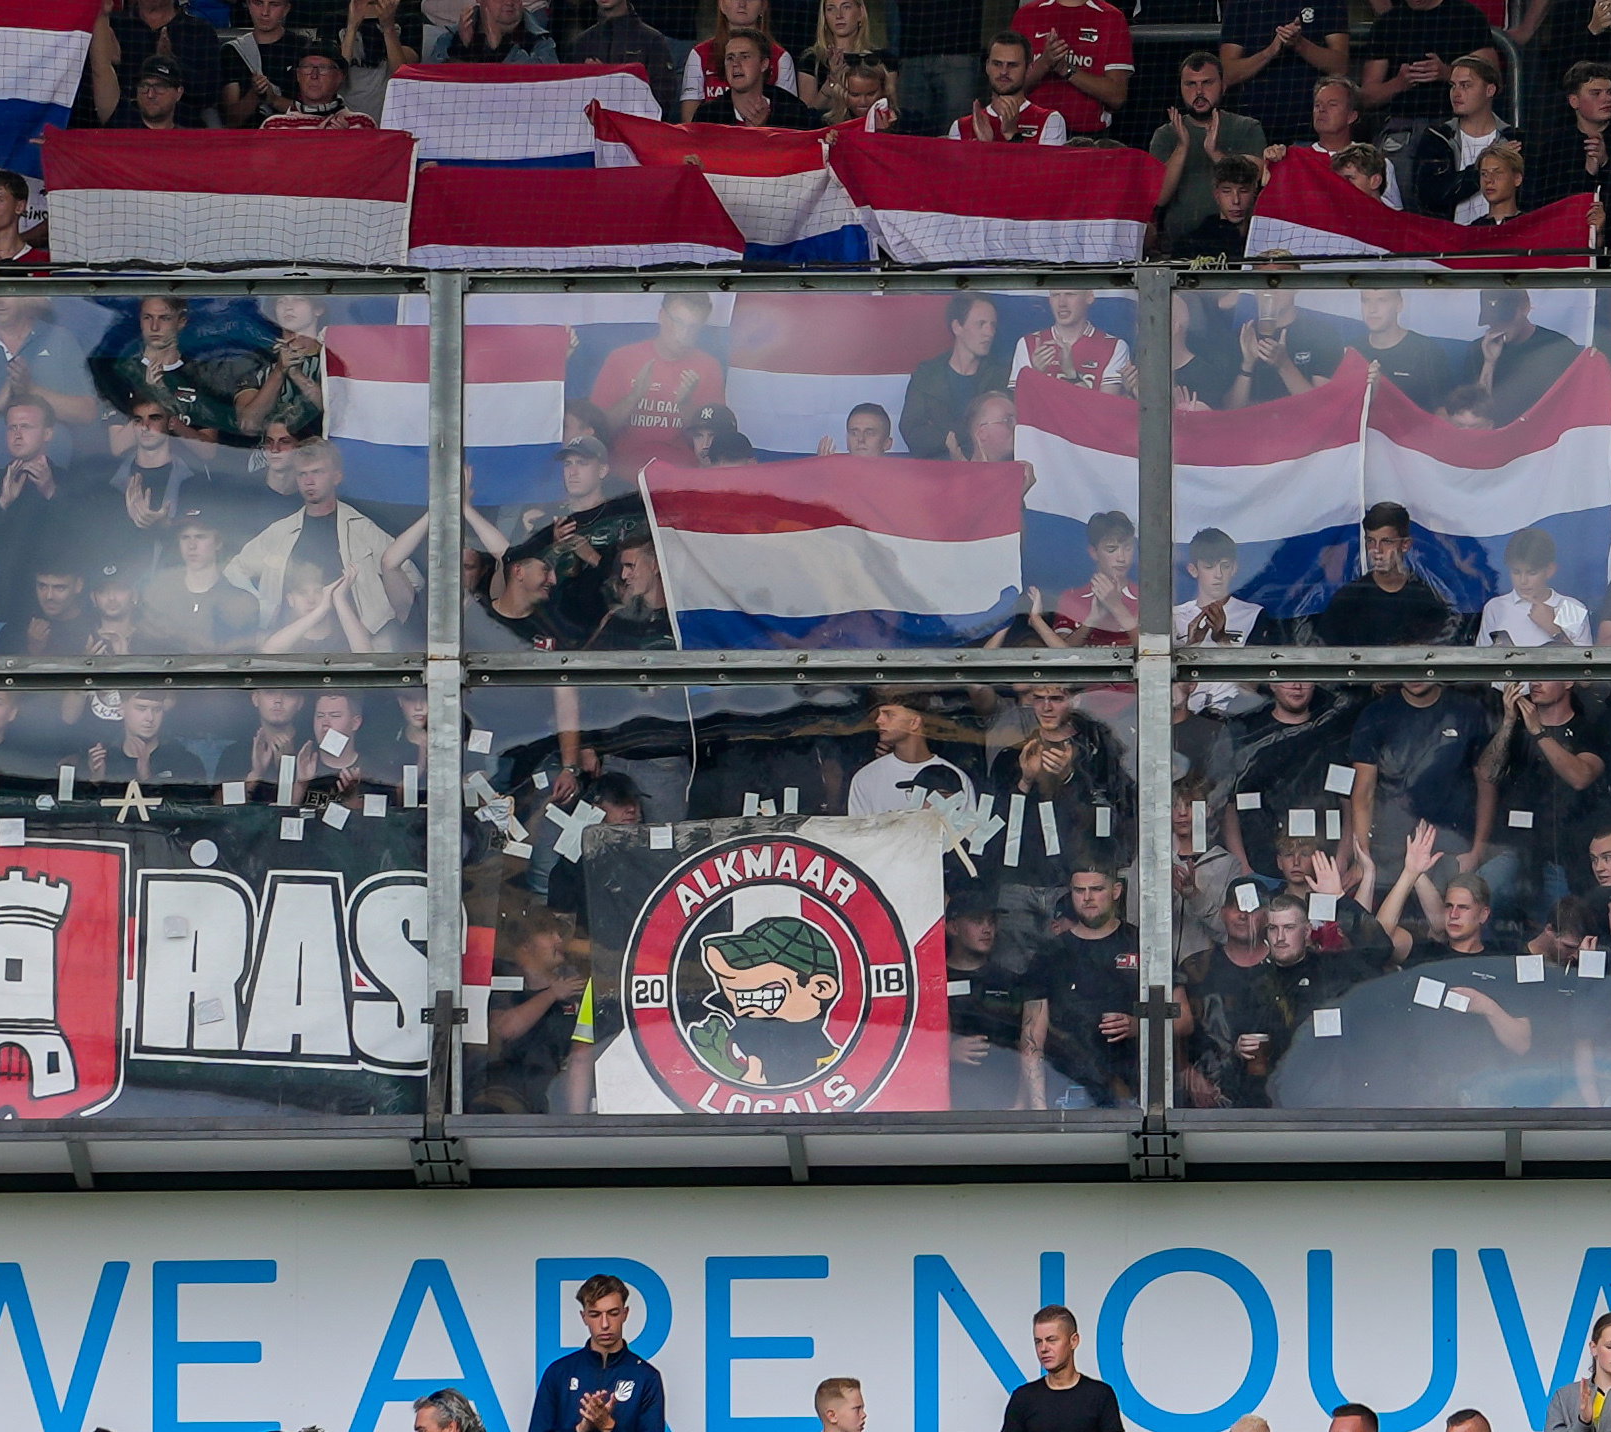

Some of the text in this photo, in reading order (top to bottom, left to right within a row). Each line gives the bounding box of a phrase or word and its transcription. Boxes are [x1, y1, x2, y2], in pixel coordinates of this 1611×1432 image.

[630, 416, 669, 428] UROPA
[675, 845, 858, 917] ALKMAAR
[634, 968, 905, 1004] 20 18
